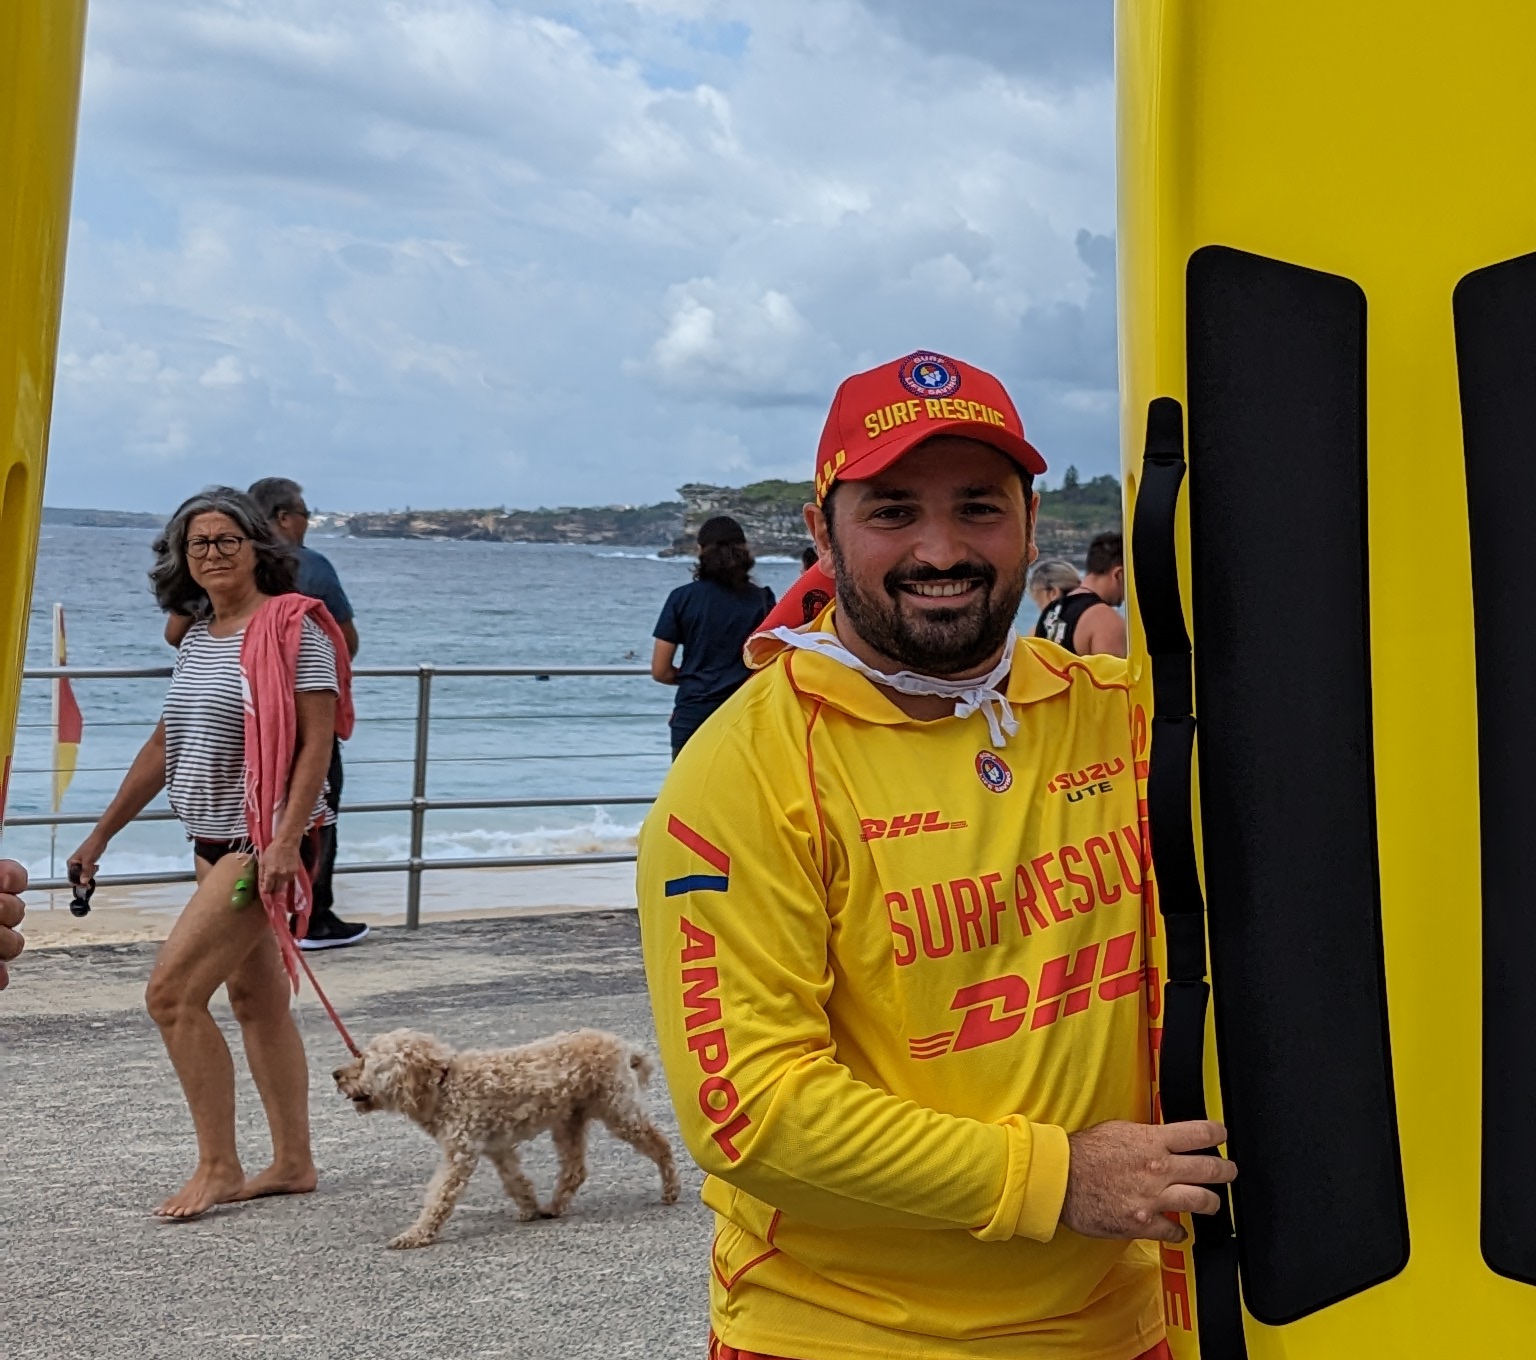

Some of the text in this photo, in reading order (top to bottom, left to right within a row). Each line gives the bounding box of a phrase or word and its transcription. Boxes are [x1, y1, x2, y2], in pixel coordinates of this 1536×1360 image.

[913, 355, 945, 365] SURF
[864, 398, 1006, 439] SURF RESCUE
[1047, 757, 1125, 794] ISUZU
[1067, 781, 1114, 803] UTE
[861, 811, 950, 841] DHL
[884, 824, 1146, 967] SURF RESCU
[950, 930, 1144, 1053] DHL
[679, 915, 752, 1164] AMPOL
